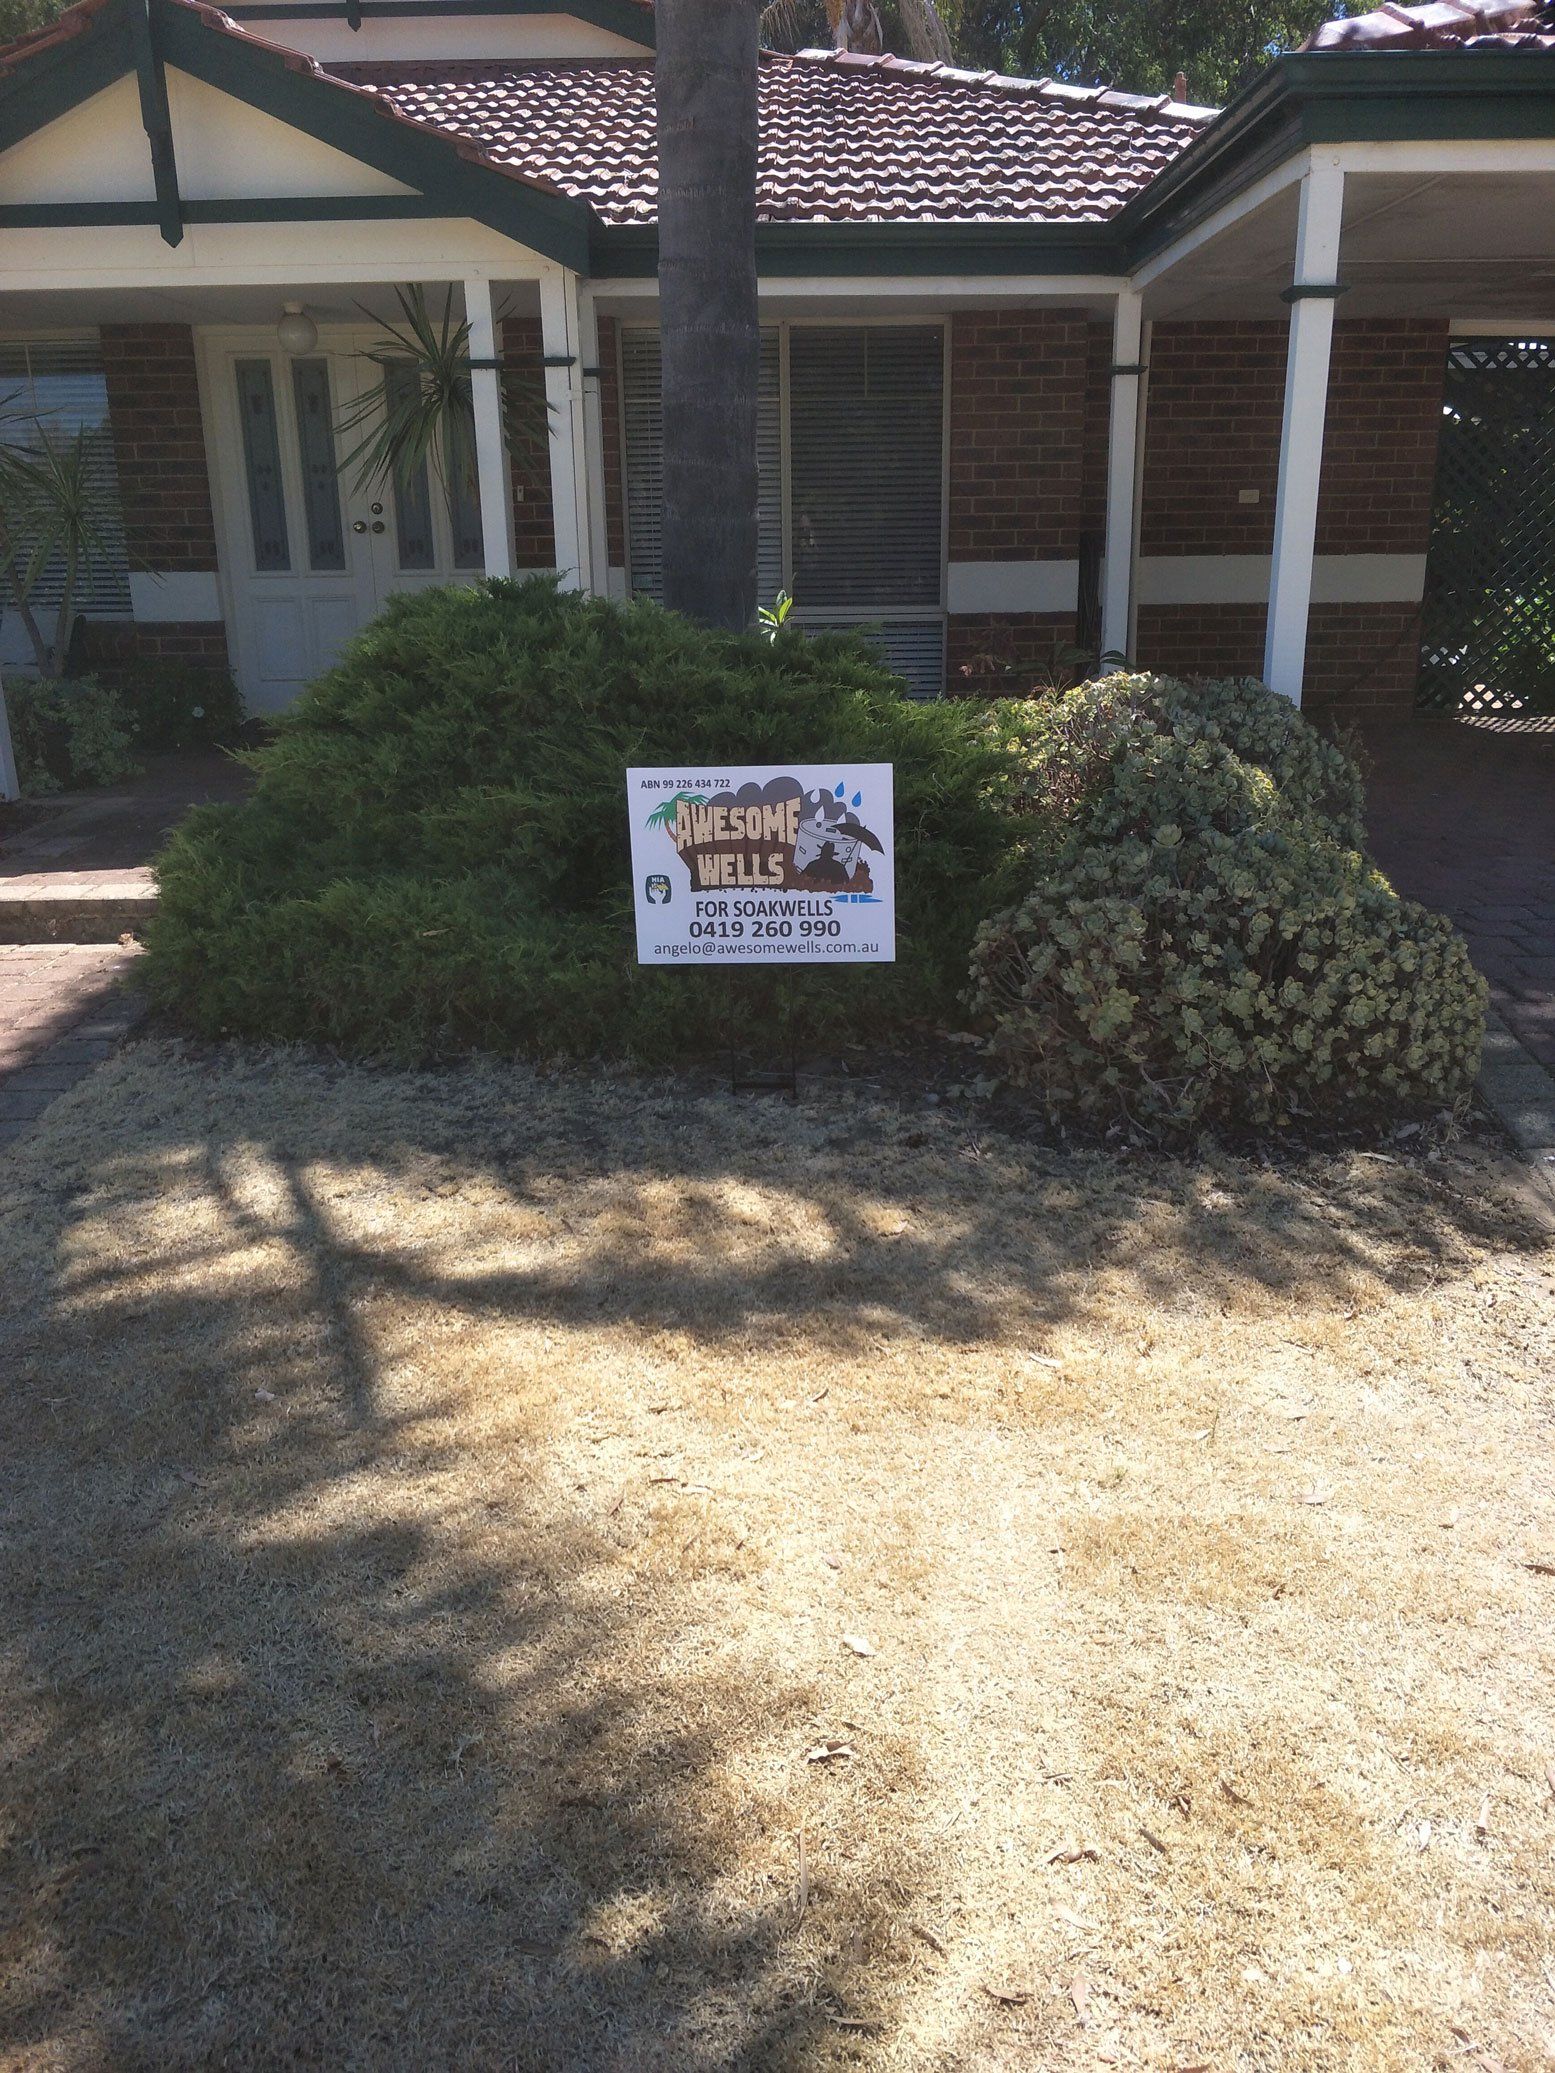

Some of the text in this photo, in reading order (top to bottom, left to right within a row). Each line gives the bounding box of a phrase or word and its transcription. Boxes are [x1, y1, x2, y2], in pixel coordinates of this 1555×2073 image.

[641, 779, 731, 789] ABN 99 226 434 722
[676, 797, 802, 852] AWESOME
[697, 852, 784, 886] WELLS
[696, 900, 833, 917] FOR SOAKWELLS
[689, 920, 841, 938] 0419 260 990
[654, 941, 879, 957] angelo@awesomewells.com.au
